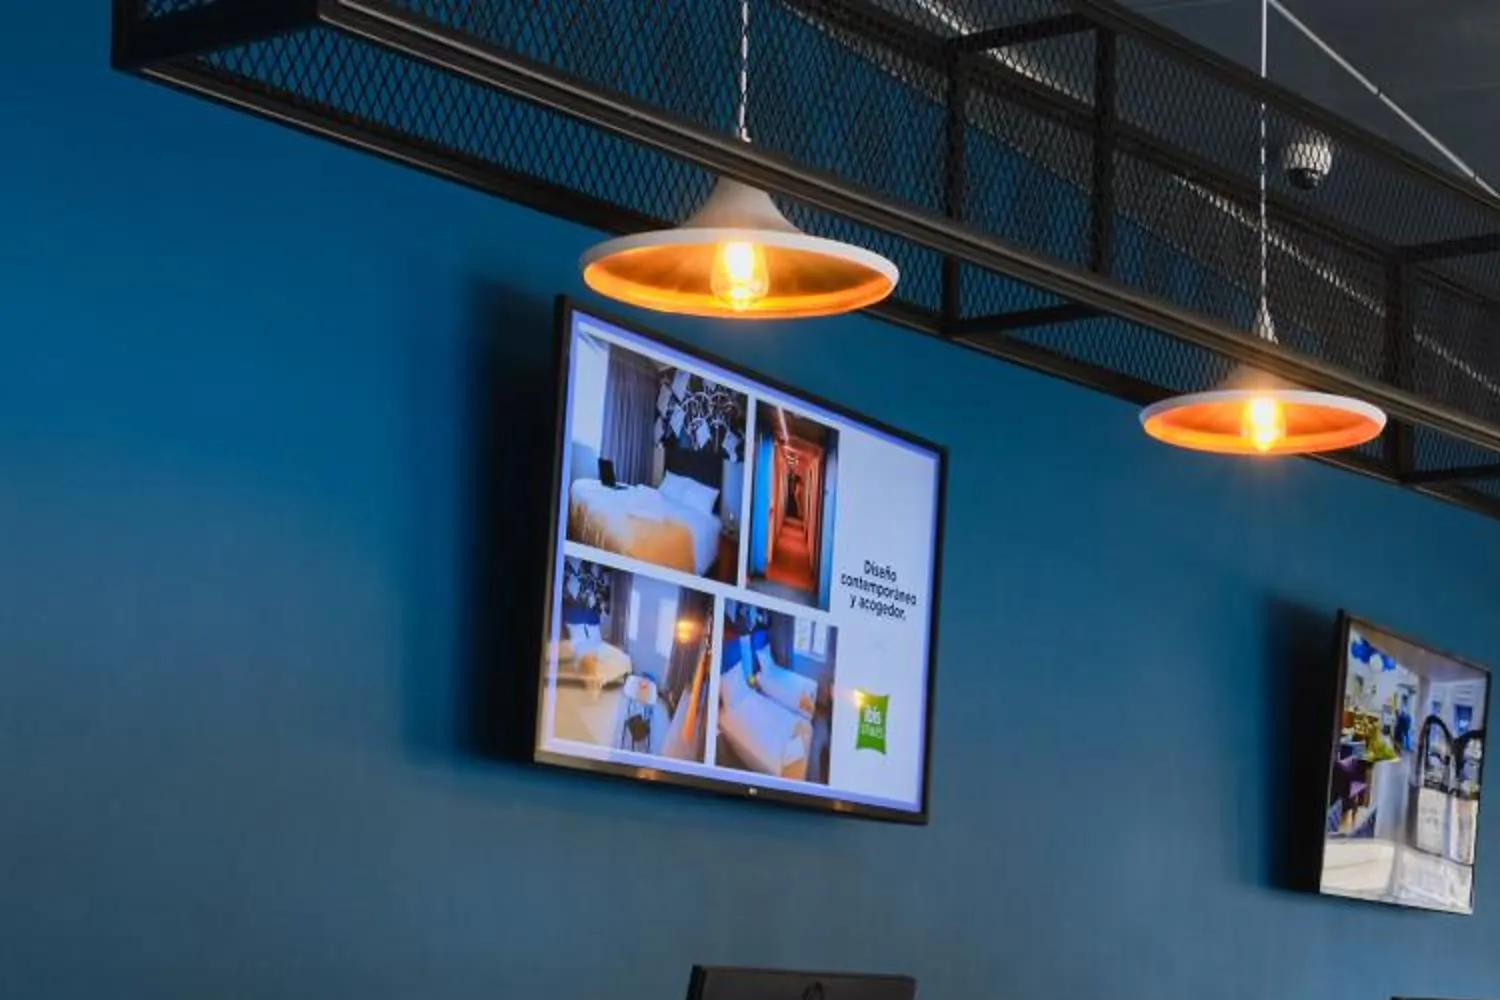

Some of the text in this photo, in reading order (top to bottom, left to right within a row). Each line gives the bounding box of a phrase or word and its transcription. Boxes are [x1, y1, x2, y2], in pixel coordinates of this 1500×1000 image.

[864, 560, 897, 582] Diseño
[840, 573, 917, 605] contemporáneo
[849, 594, 857, 609] y
